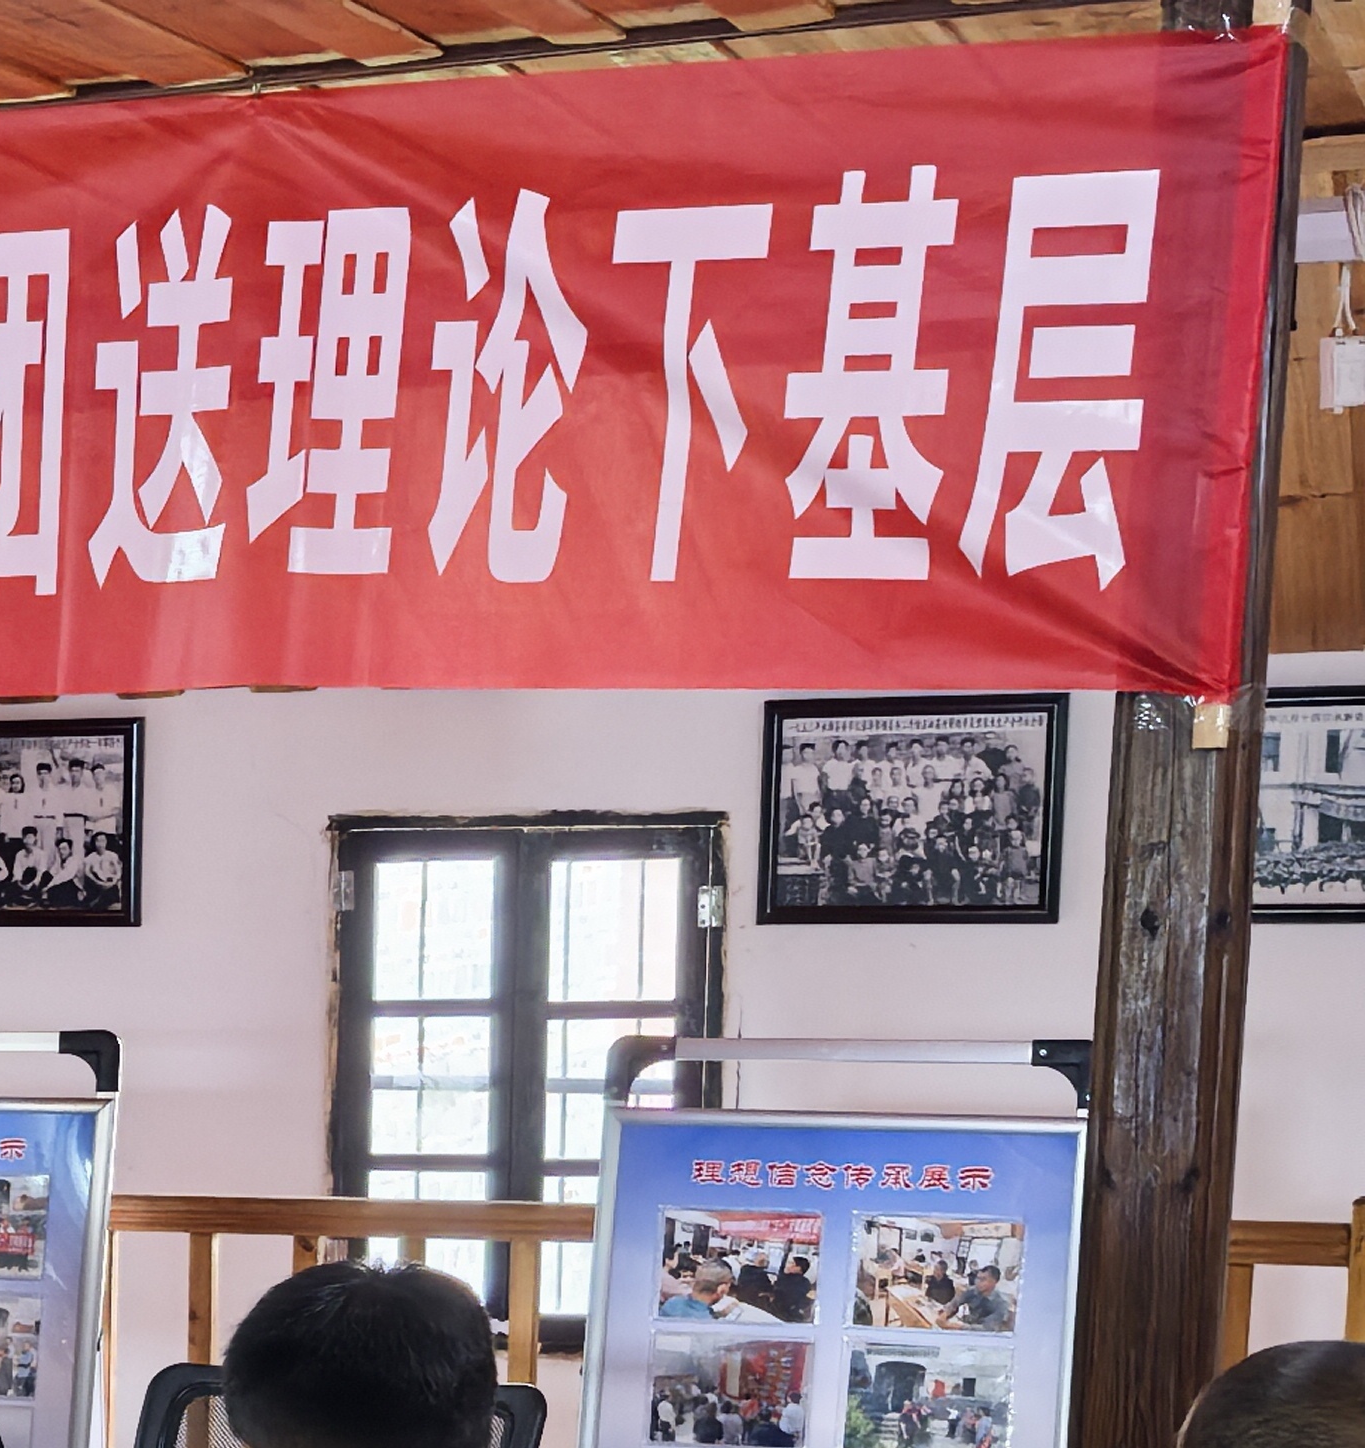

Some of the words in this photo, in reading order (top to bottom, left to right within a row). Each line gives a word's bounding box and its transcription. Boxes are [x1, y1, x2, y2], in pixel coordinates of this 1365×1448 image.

[690, 1157, 996, 1192] 理想信念传承展示
